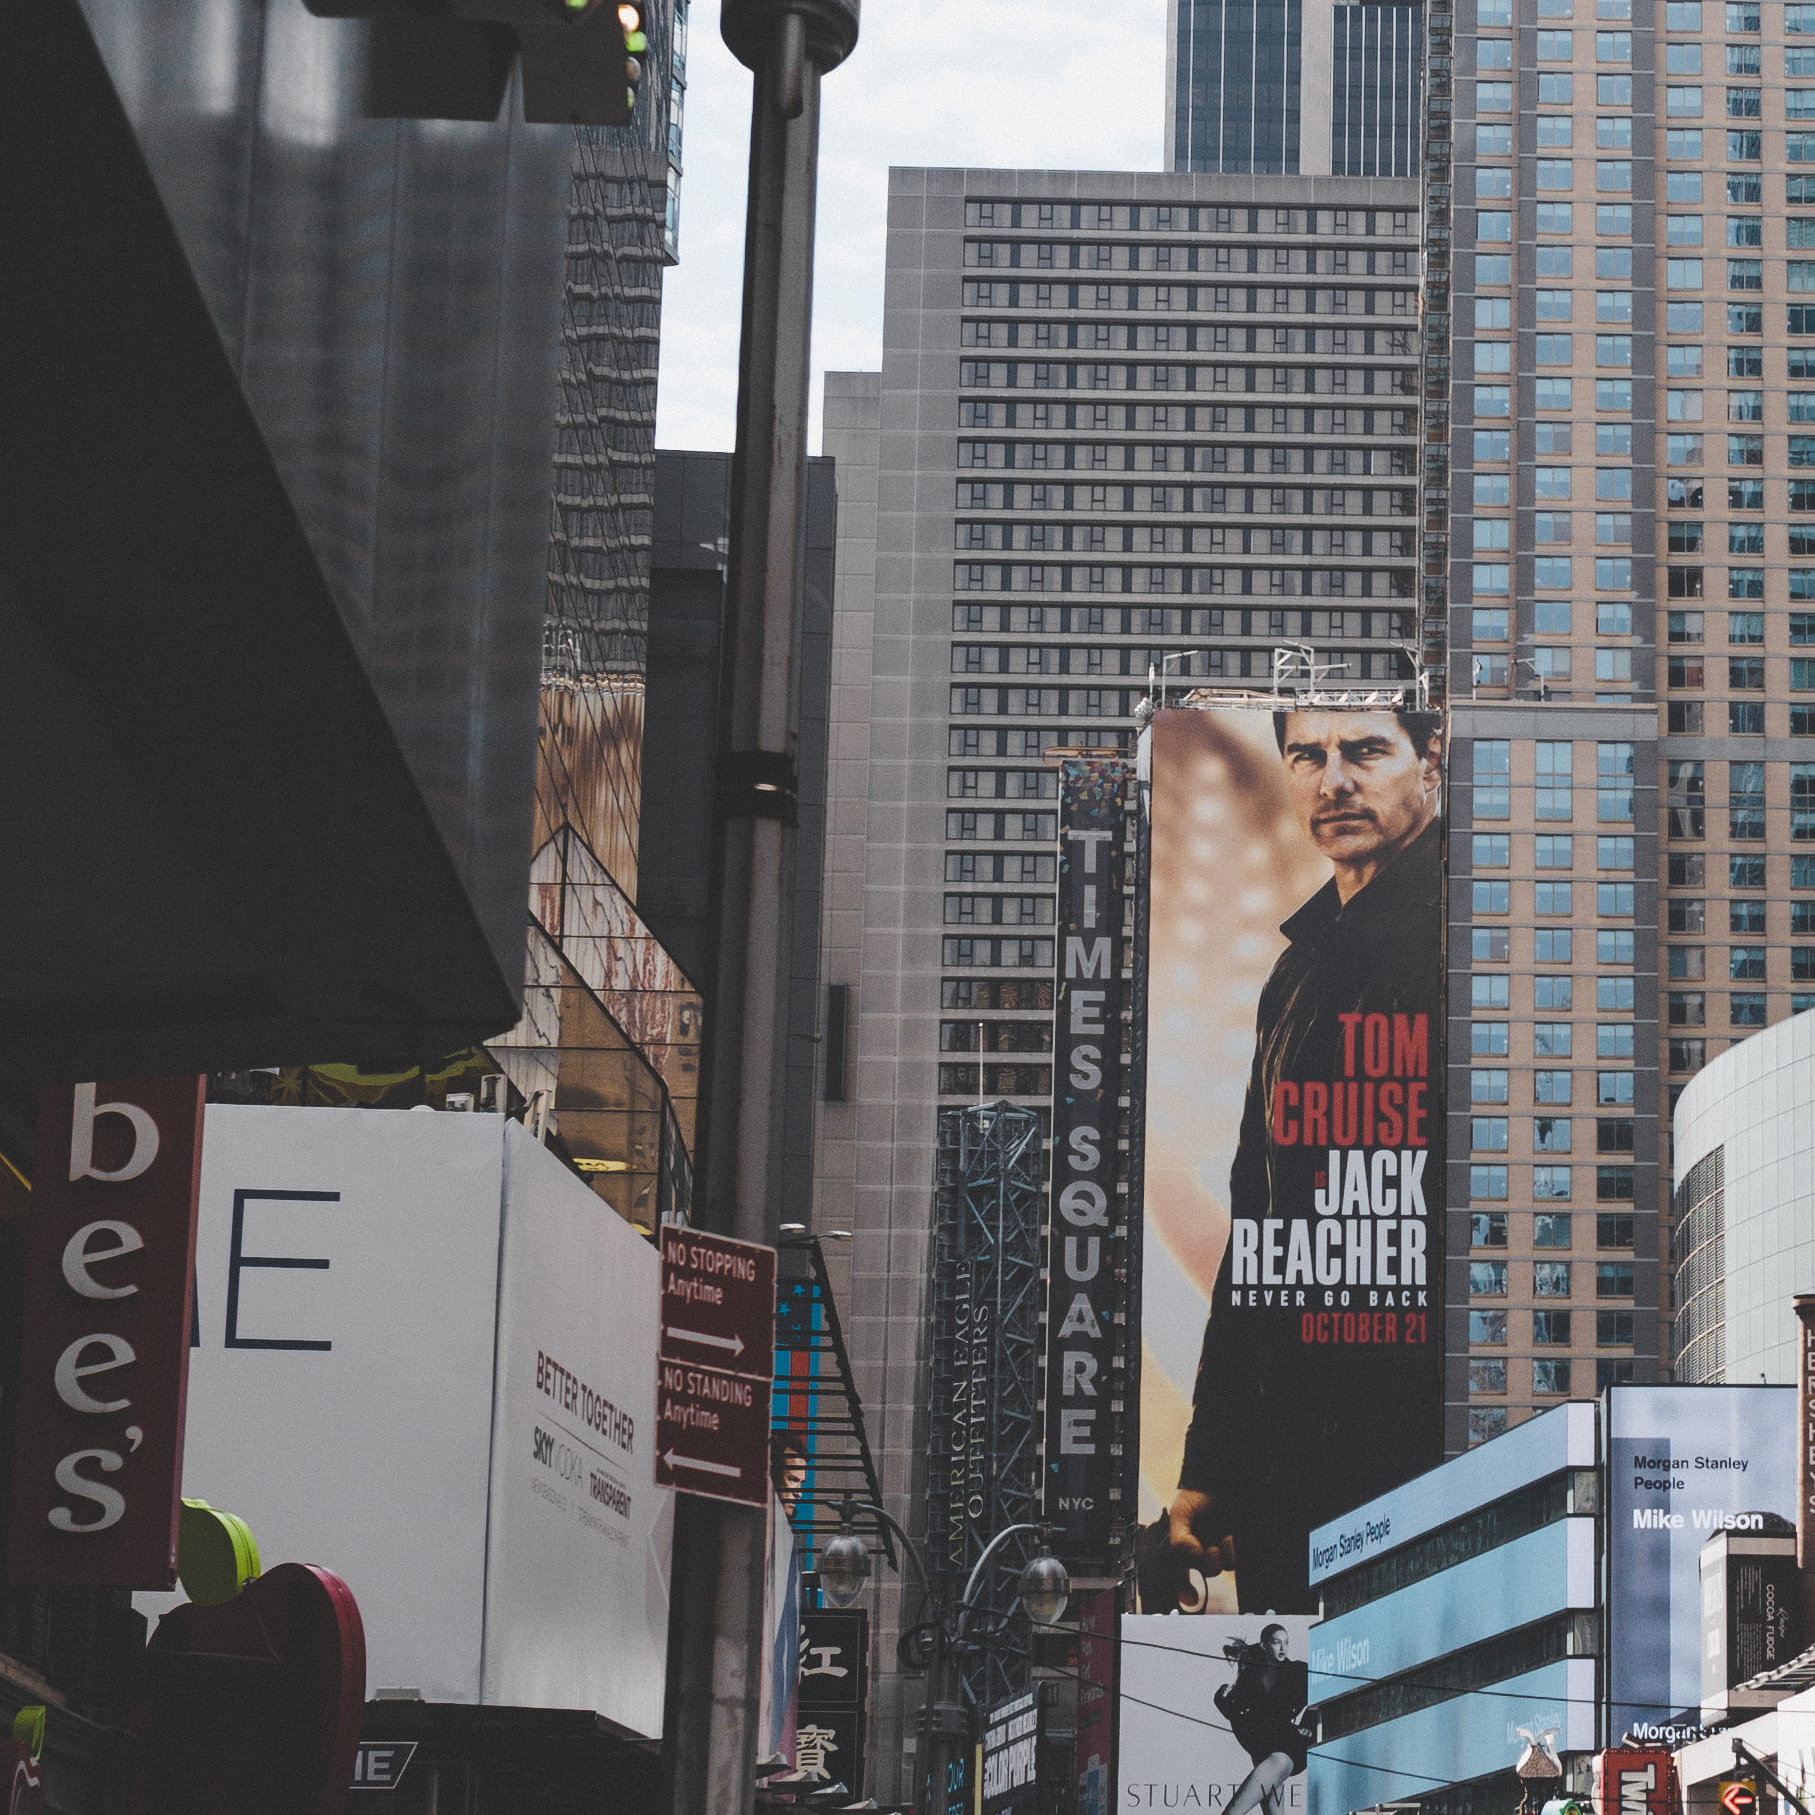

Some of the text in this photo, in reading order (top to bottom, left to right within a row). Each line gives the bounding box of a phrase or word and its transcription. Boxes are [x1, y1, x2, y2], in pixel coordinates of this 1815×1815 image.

[1338, 1013, 1429, 1077] TOM
[1272, 1081, 1428, 1147] CRUISE
[1055, 830, 1112, 1455] TIMES SQUARE
[1315, 1150, 1428, 1216] JACK
[668, 1240, 756, 1282] NO STOPPING
[1232, 1219, 1427, 1286] REACHER
[668, 1272, 723, 1305] Anytime
[1232, 1291, 1428, 1307] NEVER GO BACK
[1302, 1312, 1427, 1343] OCTOBER 21
[537, 1351, 634, 1454] BETTER TOGETHER
[664, 1368, 752, 1407] NO STANDING
[664, 1400, 719, 1431] Anytime
[949, 1260, 972, 1565] AMERICAN EAGLE
[968, 1304, 990, 1519] OUTFITTERS
[1633, 1455, 1749, 1472] Morgan Stanley
[1633, 1476, 1685, 1491] People
[1058, 1497, 1095, 1511] NYC
[1632, 1509, 1764, 1530] Mike Wilson
[1311, 1514, 1391, 1572] Morgan Stanley People
[1766, 1584, 1775, 1661] COCOA FUDGE
[1311, 1636, 1370, 1676] Mike Wilson
[1126, 1783, 1238, 1808] STUART
